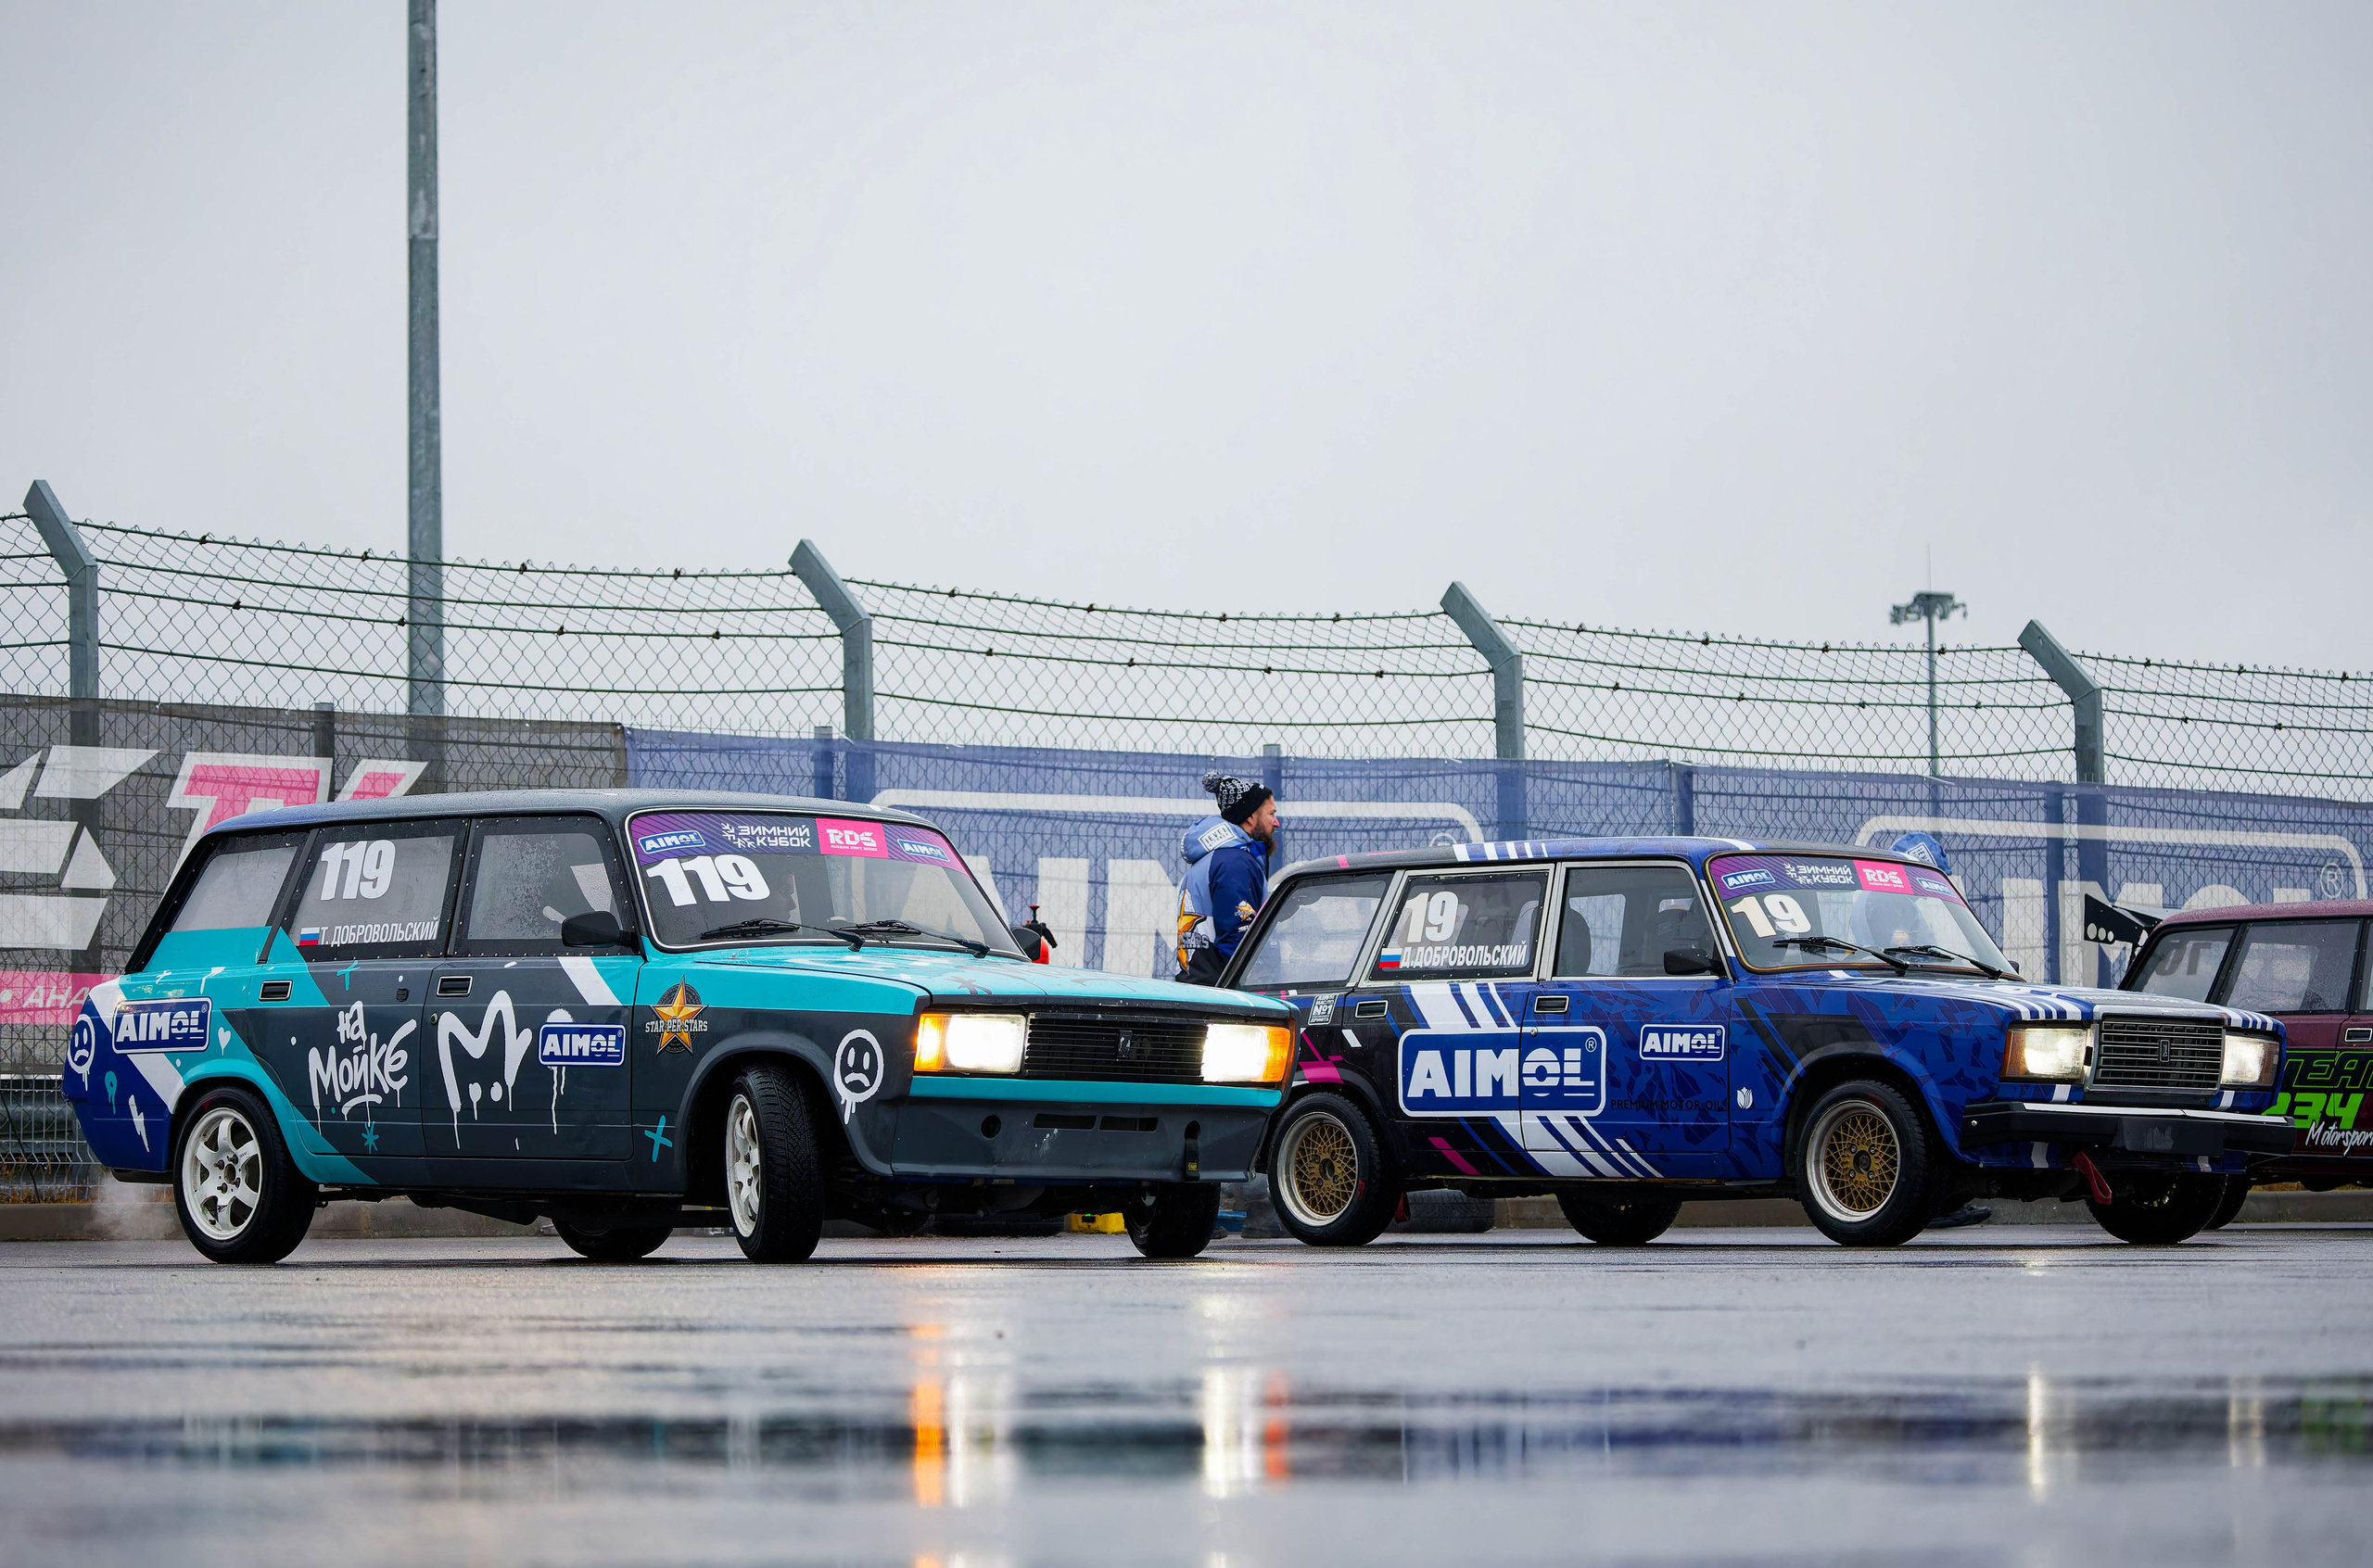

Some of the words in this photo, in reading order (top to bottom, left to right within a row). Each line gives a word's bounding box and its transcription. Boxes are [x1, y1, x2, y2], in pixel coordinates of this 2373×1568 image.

[738, 825, 810, 837] ЗИМНИЙ
[826, 828, 877, 847] RDS
[645, 834, 703, 851] AIMOL
[756, 837, 811, 848] КУБОК
[321, 840, 397, 901] 119
[1727, 872, 1773, 887] AIMOL
[1796, 865, 1852, 876] ЗИМНИЙ
[1812, 875, 1855, 884] КУБОК
[1862, 868, 1903, 884] RDS
[646, 854, 770, 907] 119
[1403, 891, 1459, 942] 19
[1730, 893, 1811, 938] 19
[331, 916, 440, 947] ДОБРОВОЛЬСКИЙ
[116, 1010, 204, 1043] AIMOL
[645, 1019, 665, 1033] STAR
[666, 1018, 681, 1032] PER
[684, 1018, 708, 1032] STARS
[542, 1034, 621, 1057] AIMOL
[1643, 1032, 1720, 1054] AIMOL
[1407, 1047, 1595, 1098] AIMOL
[1611, 1099, 1657, 1110] PREMIUM
[1660, 1099, 1704, 1110] MOTOR
[1706, 1100, 1724, 1111] OIL
